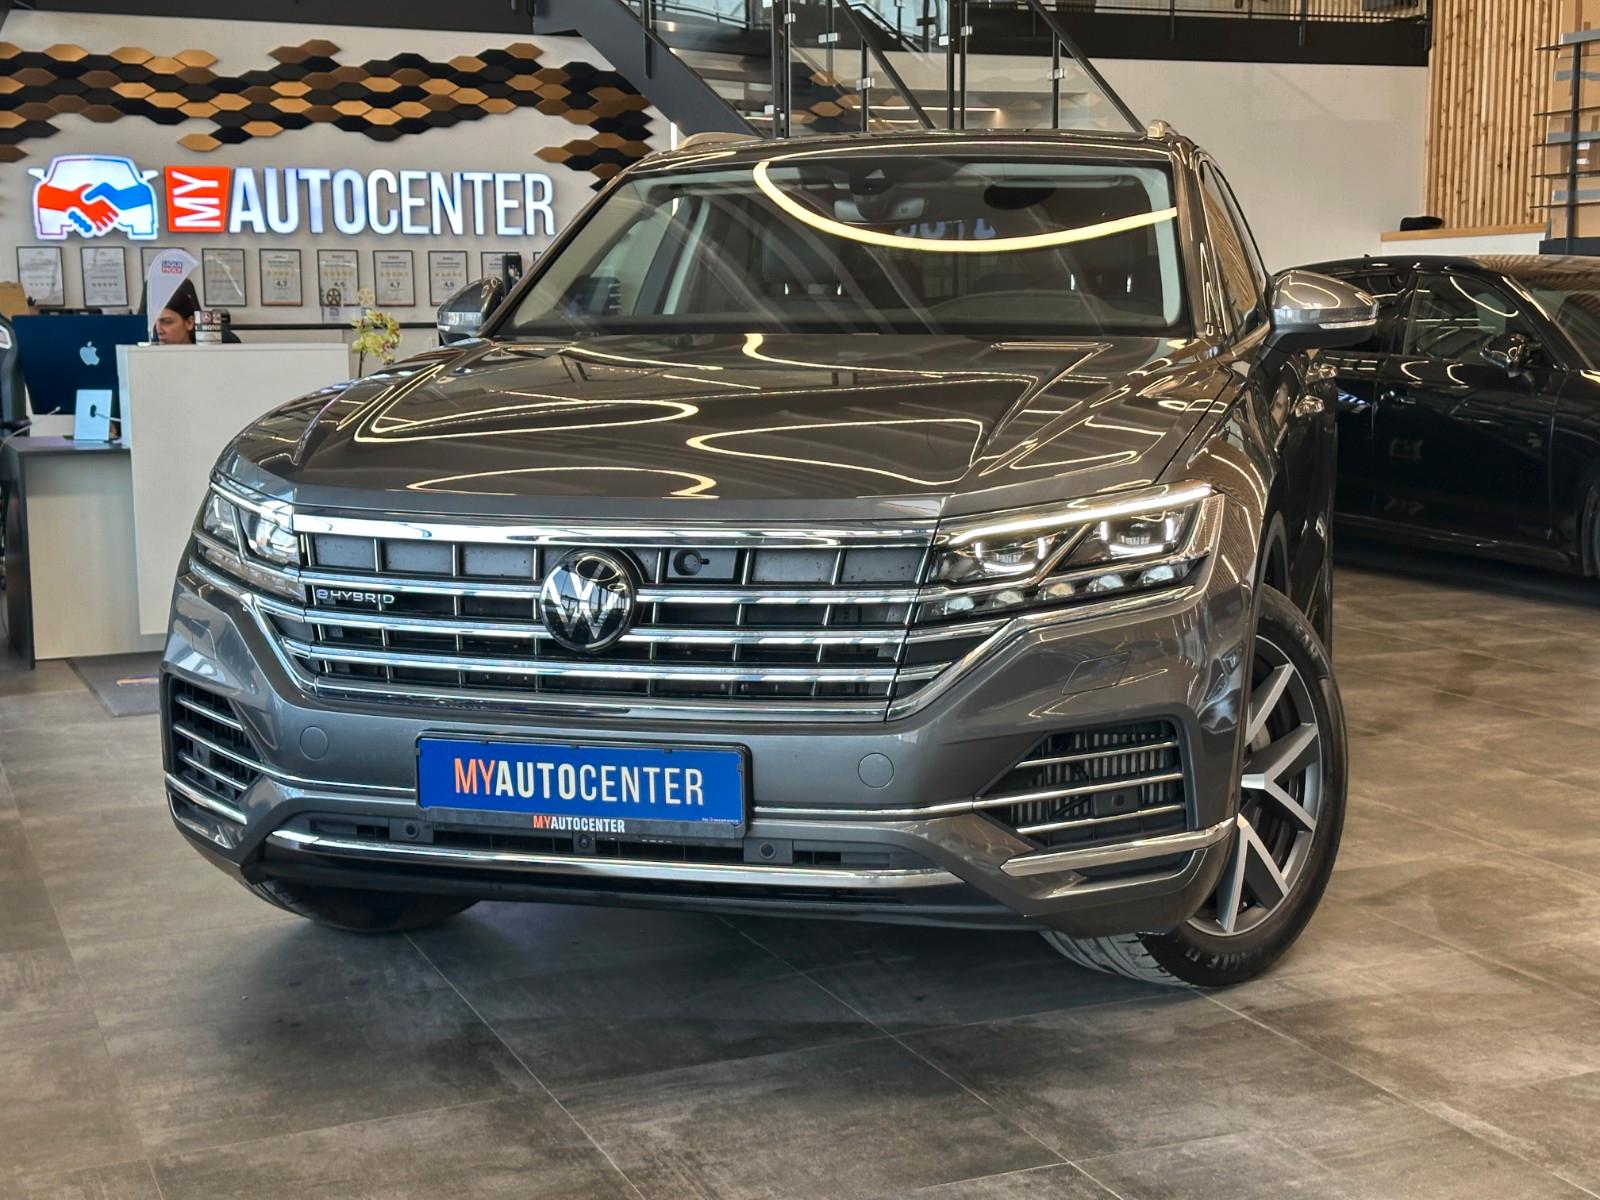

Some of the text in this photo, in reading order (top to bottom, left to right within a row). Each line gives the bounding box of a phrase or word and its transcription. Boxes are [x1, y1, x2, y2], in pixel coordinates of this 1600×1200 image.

[171, 167, 556, 236] MY AUTOCENTER
[454, 757, 704, 806] MYAUTOCENTER
[533, 815, 625, 833] MYAUTOCENTER
